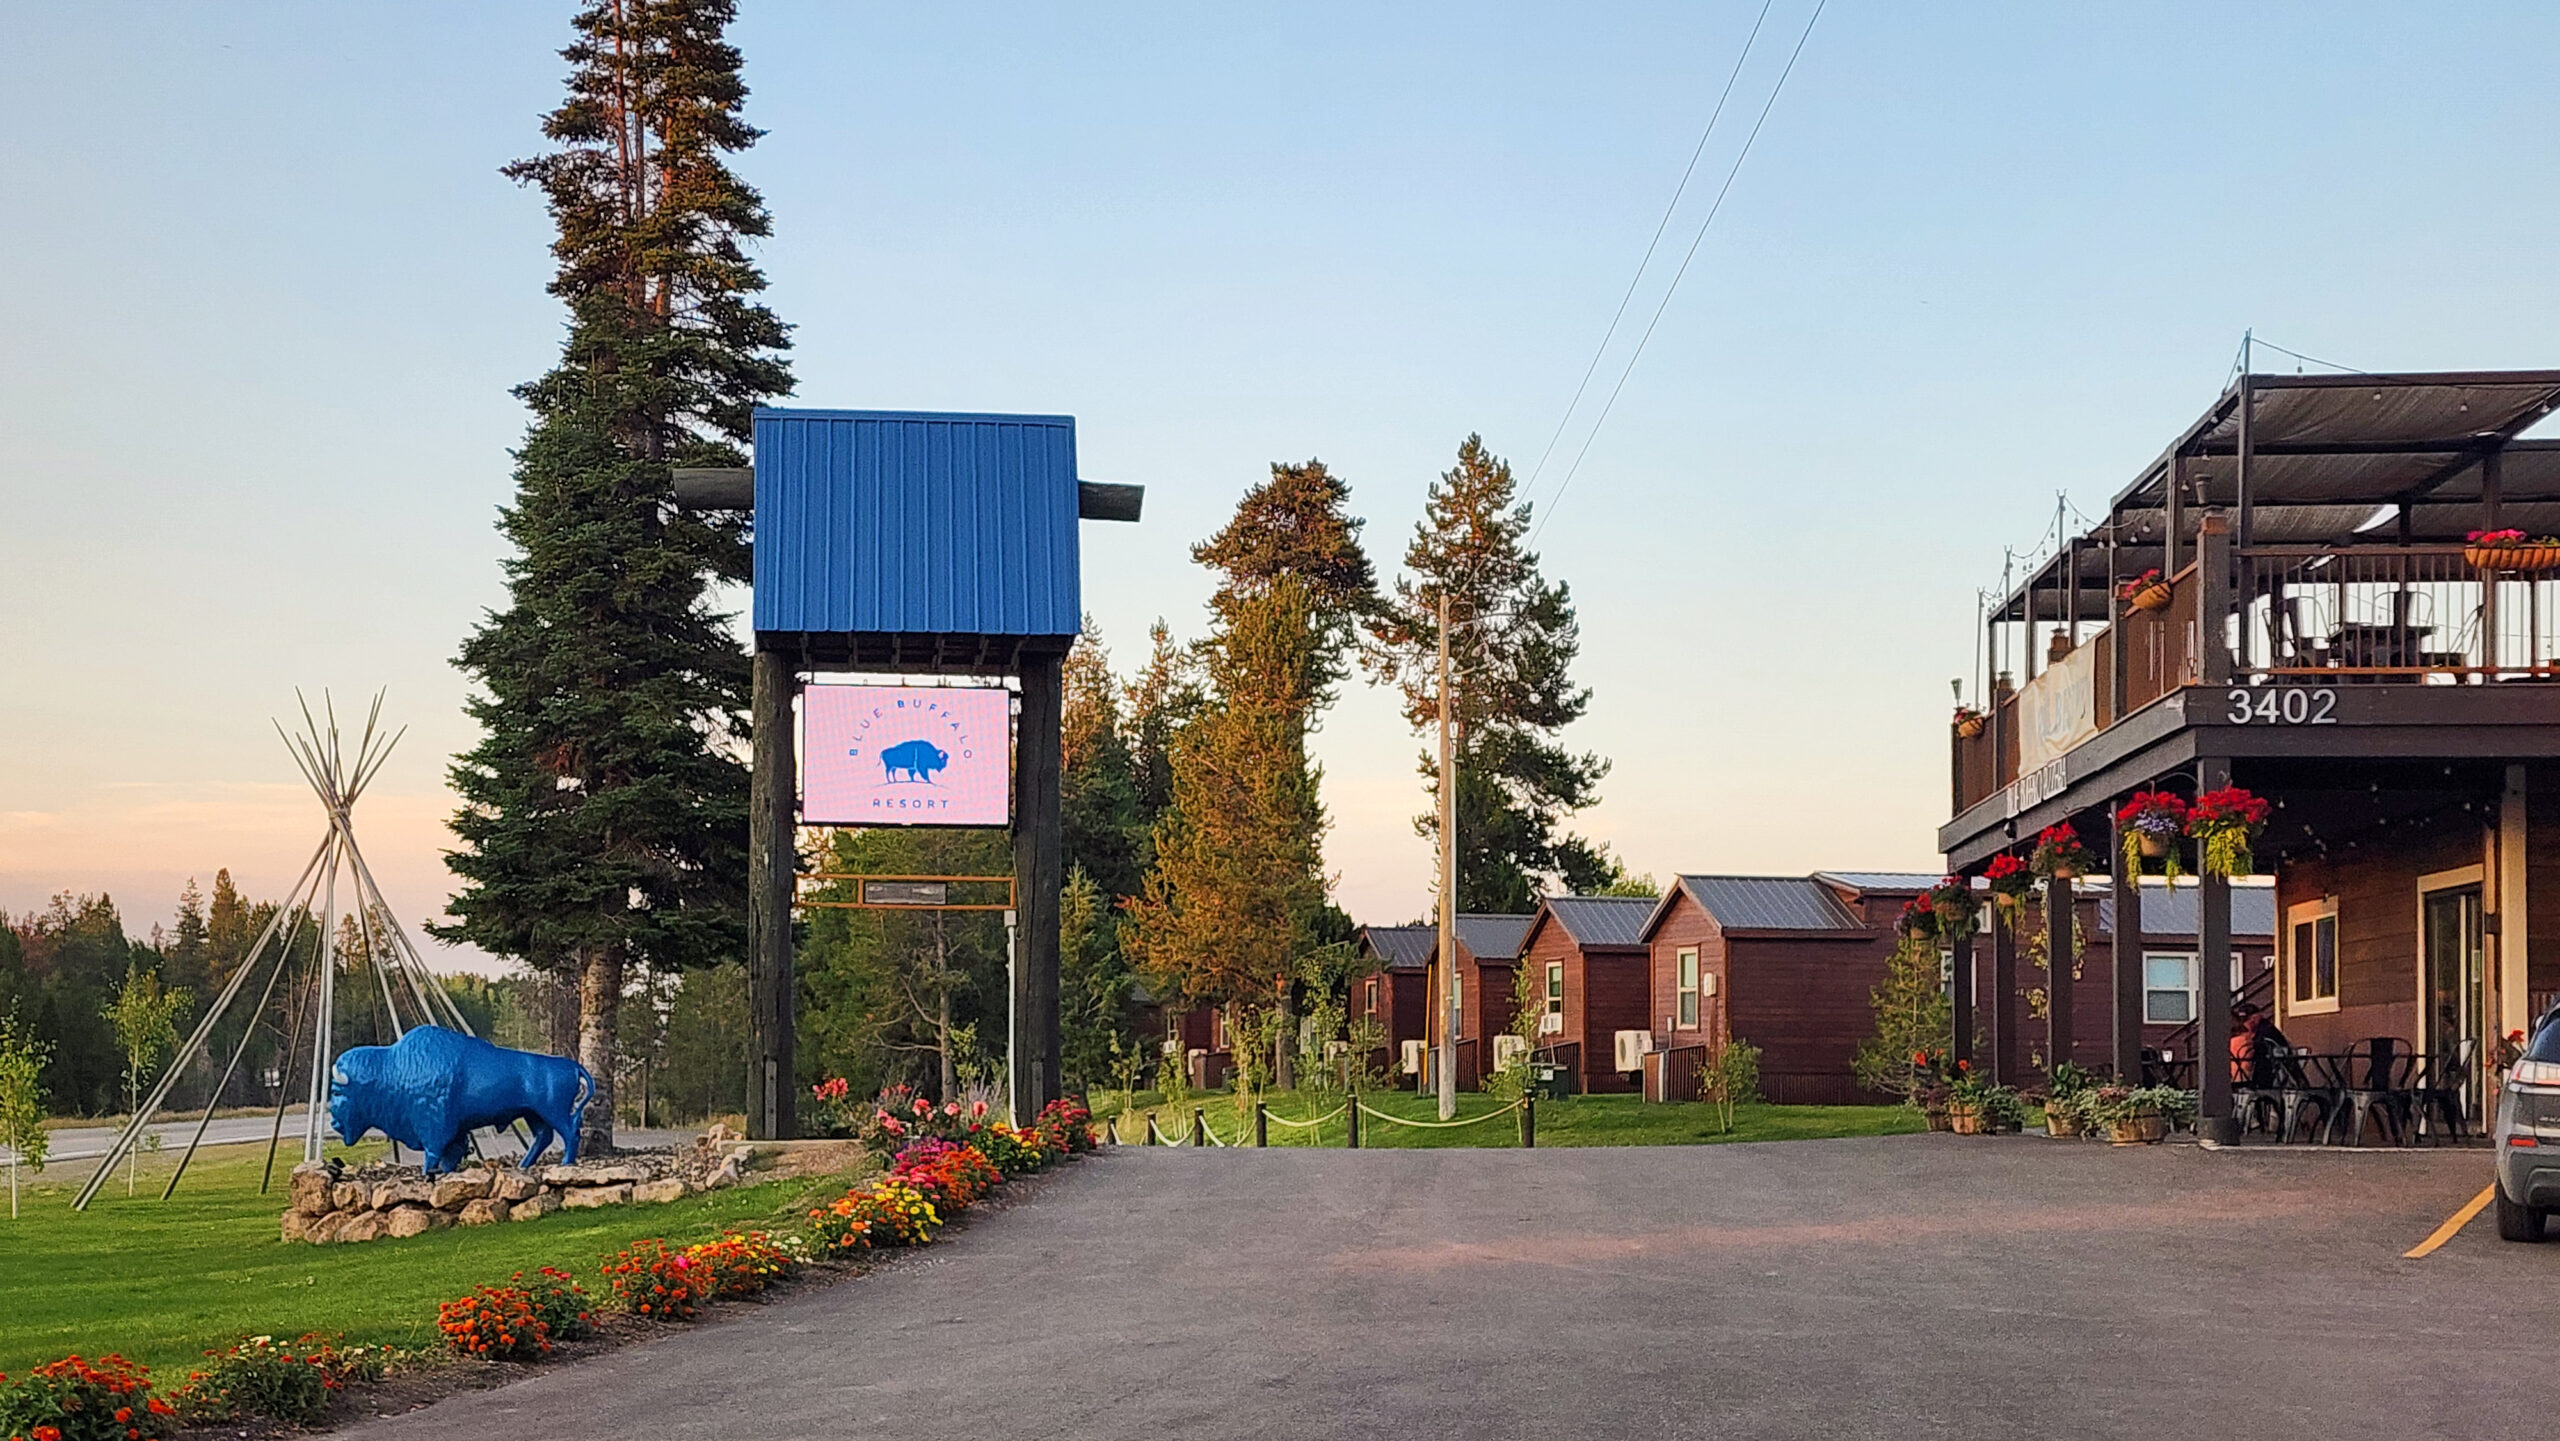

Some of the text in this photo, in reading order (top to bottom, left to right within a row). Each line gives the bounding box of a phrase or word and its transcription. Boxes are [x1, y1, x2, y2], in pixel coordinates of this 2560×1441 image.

[2227, 688, 2337, 724] 3402
[849, 699, 973, 759] BLUE BUFFALO
[872, 798, 949, 809] RESORT
